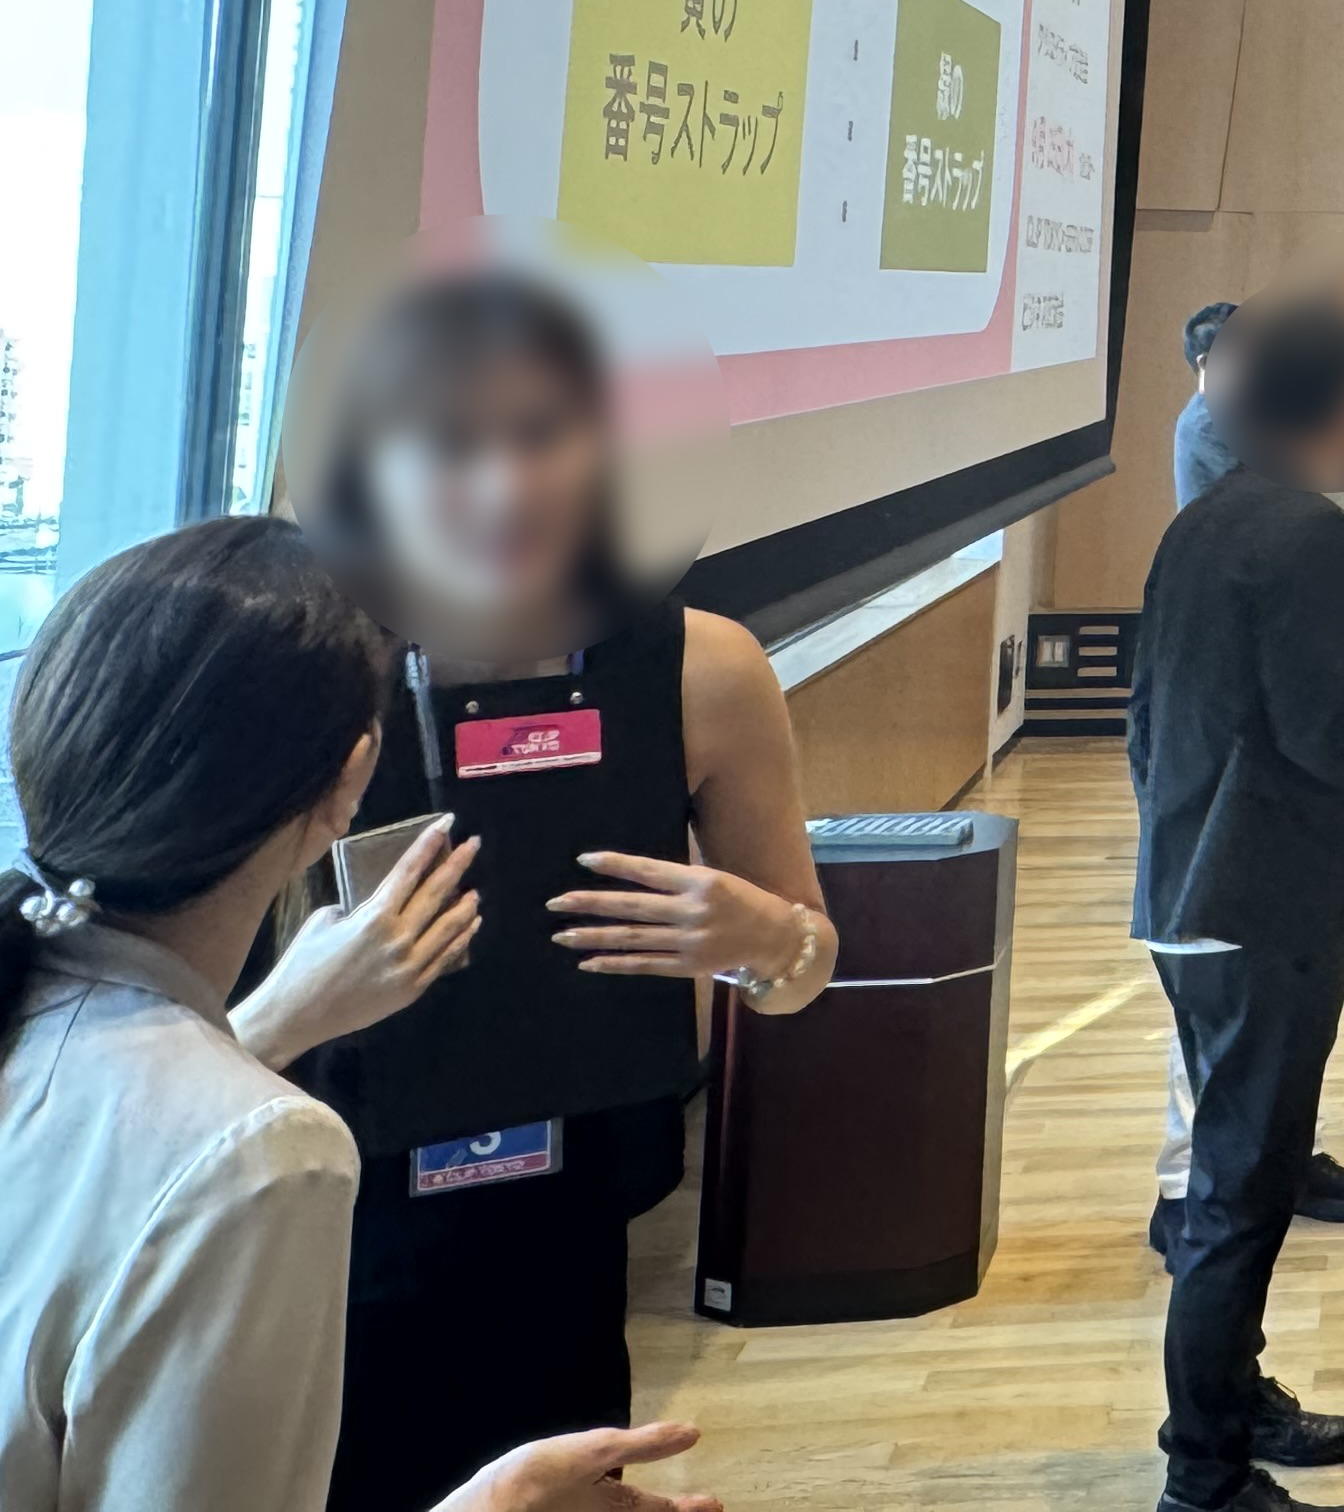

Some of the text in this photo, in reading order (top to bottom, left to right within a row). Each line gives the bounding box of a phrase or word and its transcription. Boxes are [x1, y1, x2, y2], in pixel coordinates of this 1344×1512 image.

[603, 53, 783, 176] 番号ストラップ
[902, 134, 984, 211] 番号ストラップ
